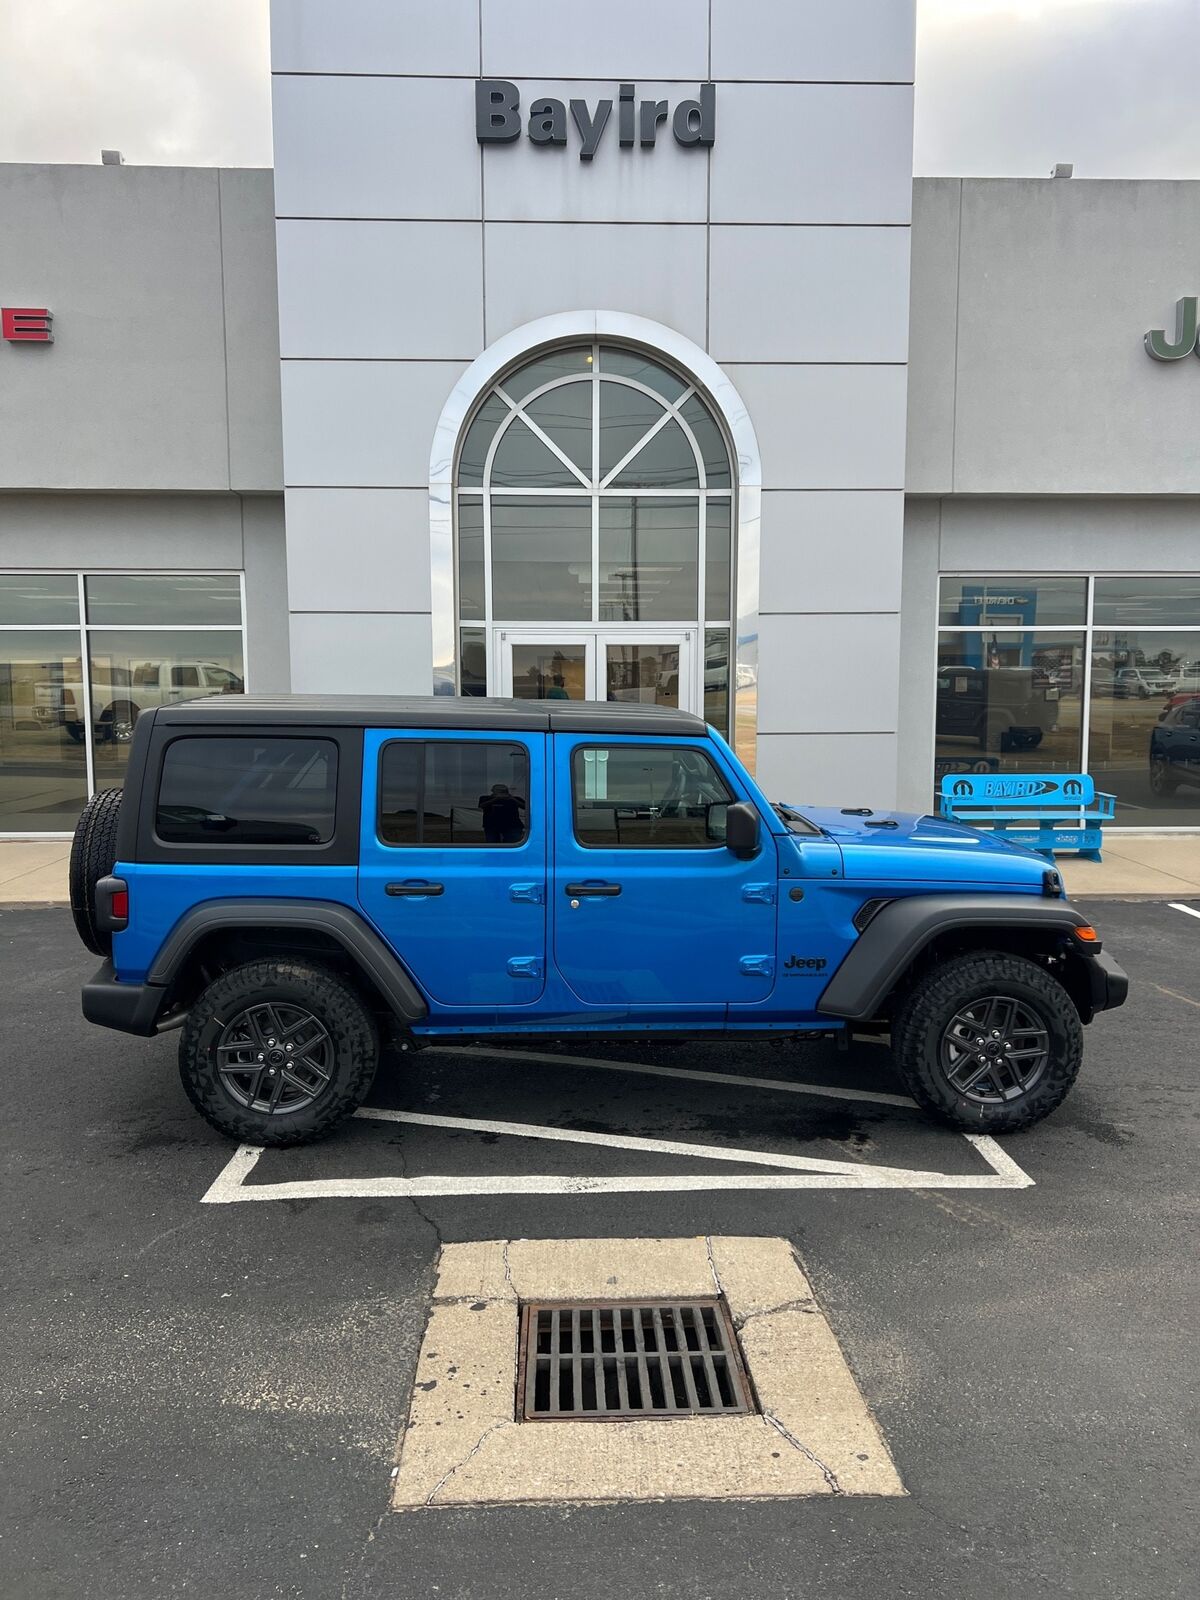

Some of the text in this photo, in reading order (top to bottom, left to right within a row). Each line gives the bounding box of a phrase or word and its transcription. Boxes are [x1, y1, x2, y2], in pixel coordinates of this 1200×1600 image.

[475, 80, 716, 161] Bayird
[1144, 296, 1200, 362] J
[984, 781, 1037, 798] BAYIRD
[784, 953, 827, 971] Jeep
